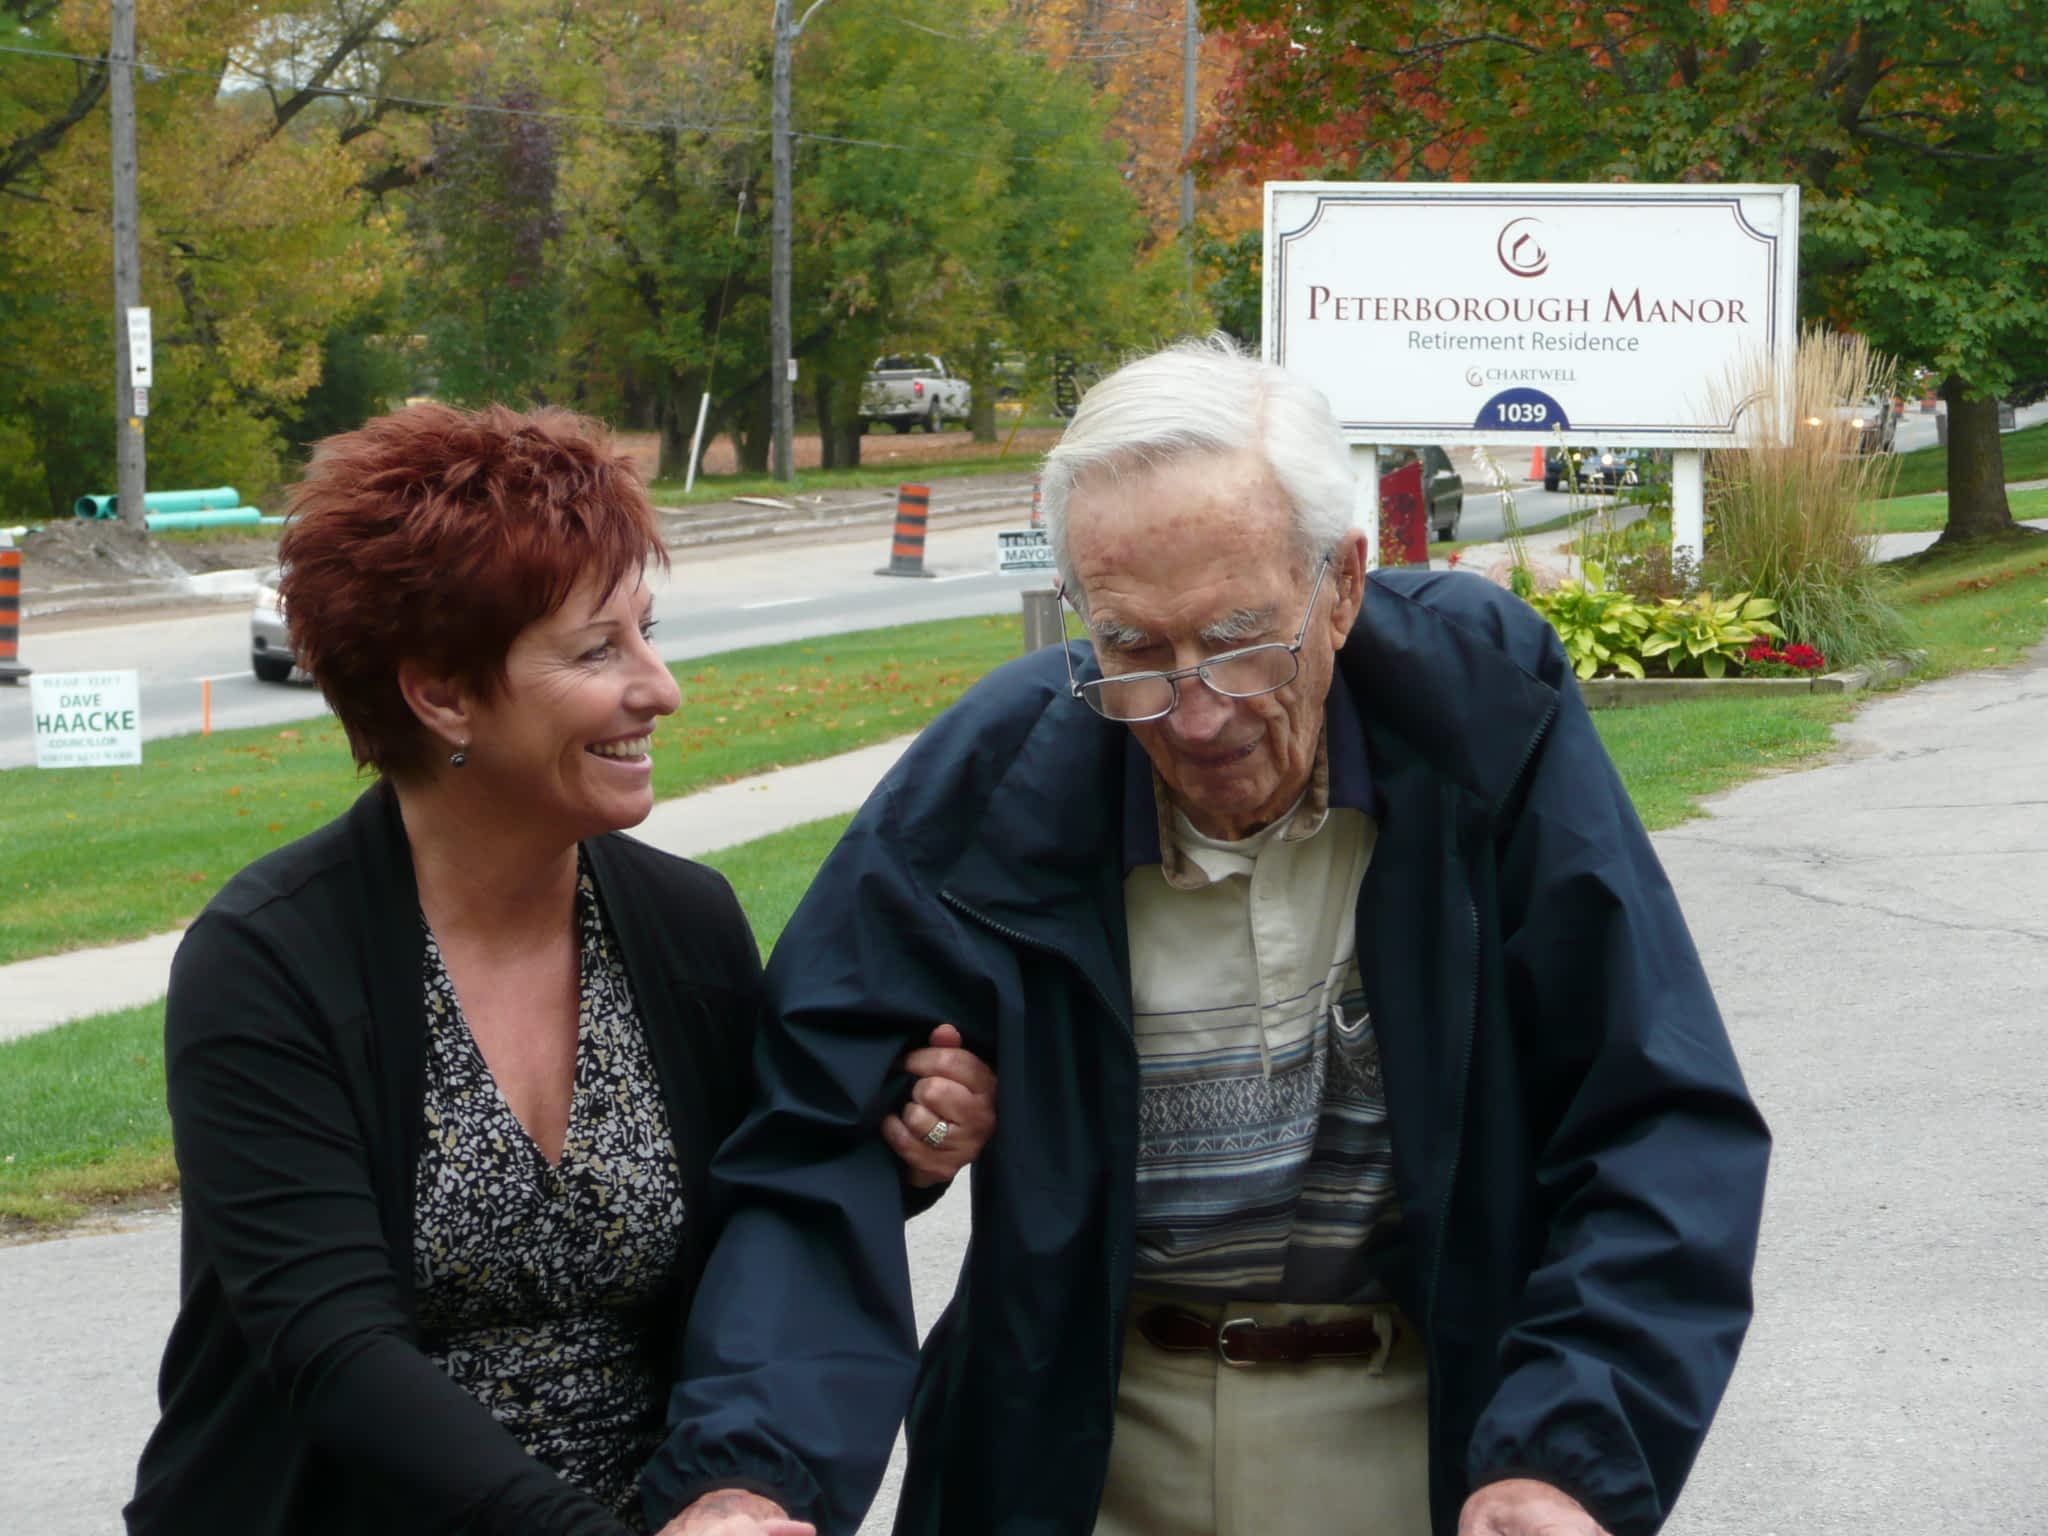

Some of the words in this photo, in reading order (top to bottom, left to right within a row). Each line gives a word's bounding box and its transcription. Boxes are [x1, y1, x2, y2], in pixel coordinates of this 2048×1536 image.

[1308, 285, 1590, 322] PETERBOROUGH
[1604, 287, 1749, 323] MANOR
[1408, 330, 1525, 350] Retirement
[1532, 331, 1639, 352] Residence
[1486, 367, 1576, 382] CHARTWELL
[1497, 403, 1547, 423] 1039
[60, 694, 102, 708] DAVE
[36, 710, 136, 734] HAACKE
